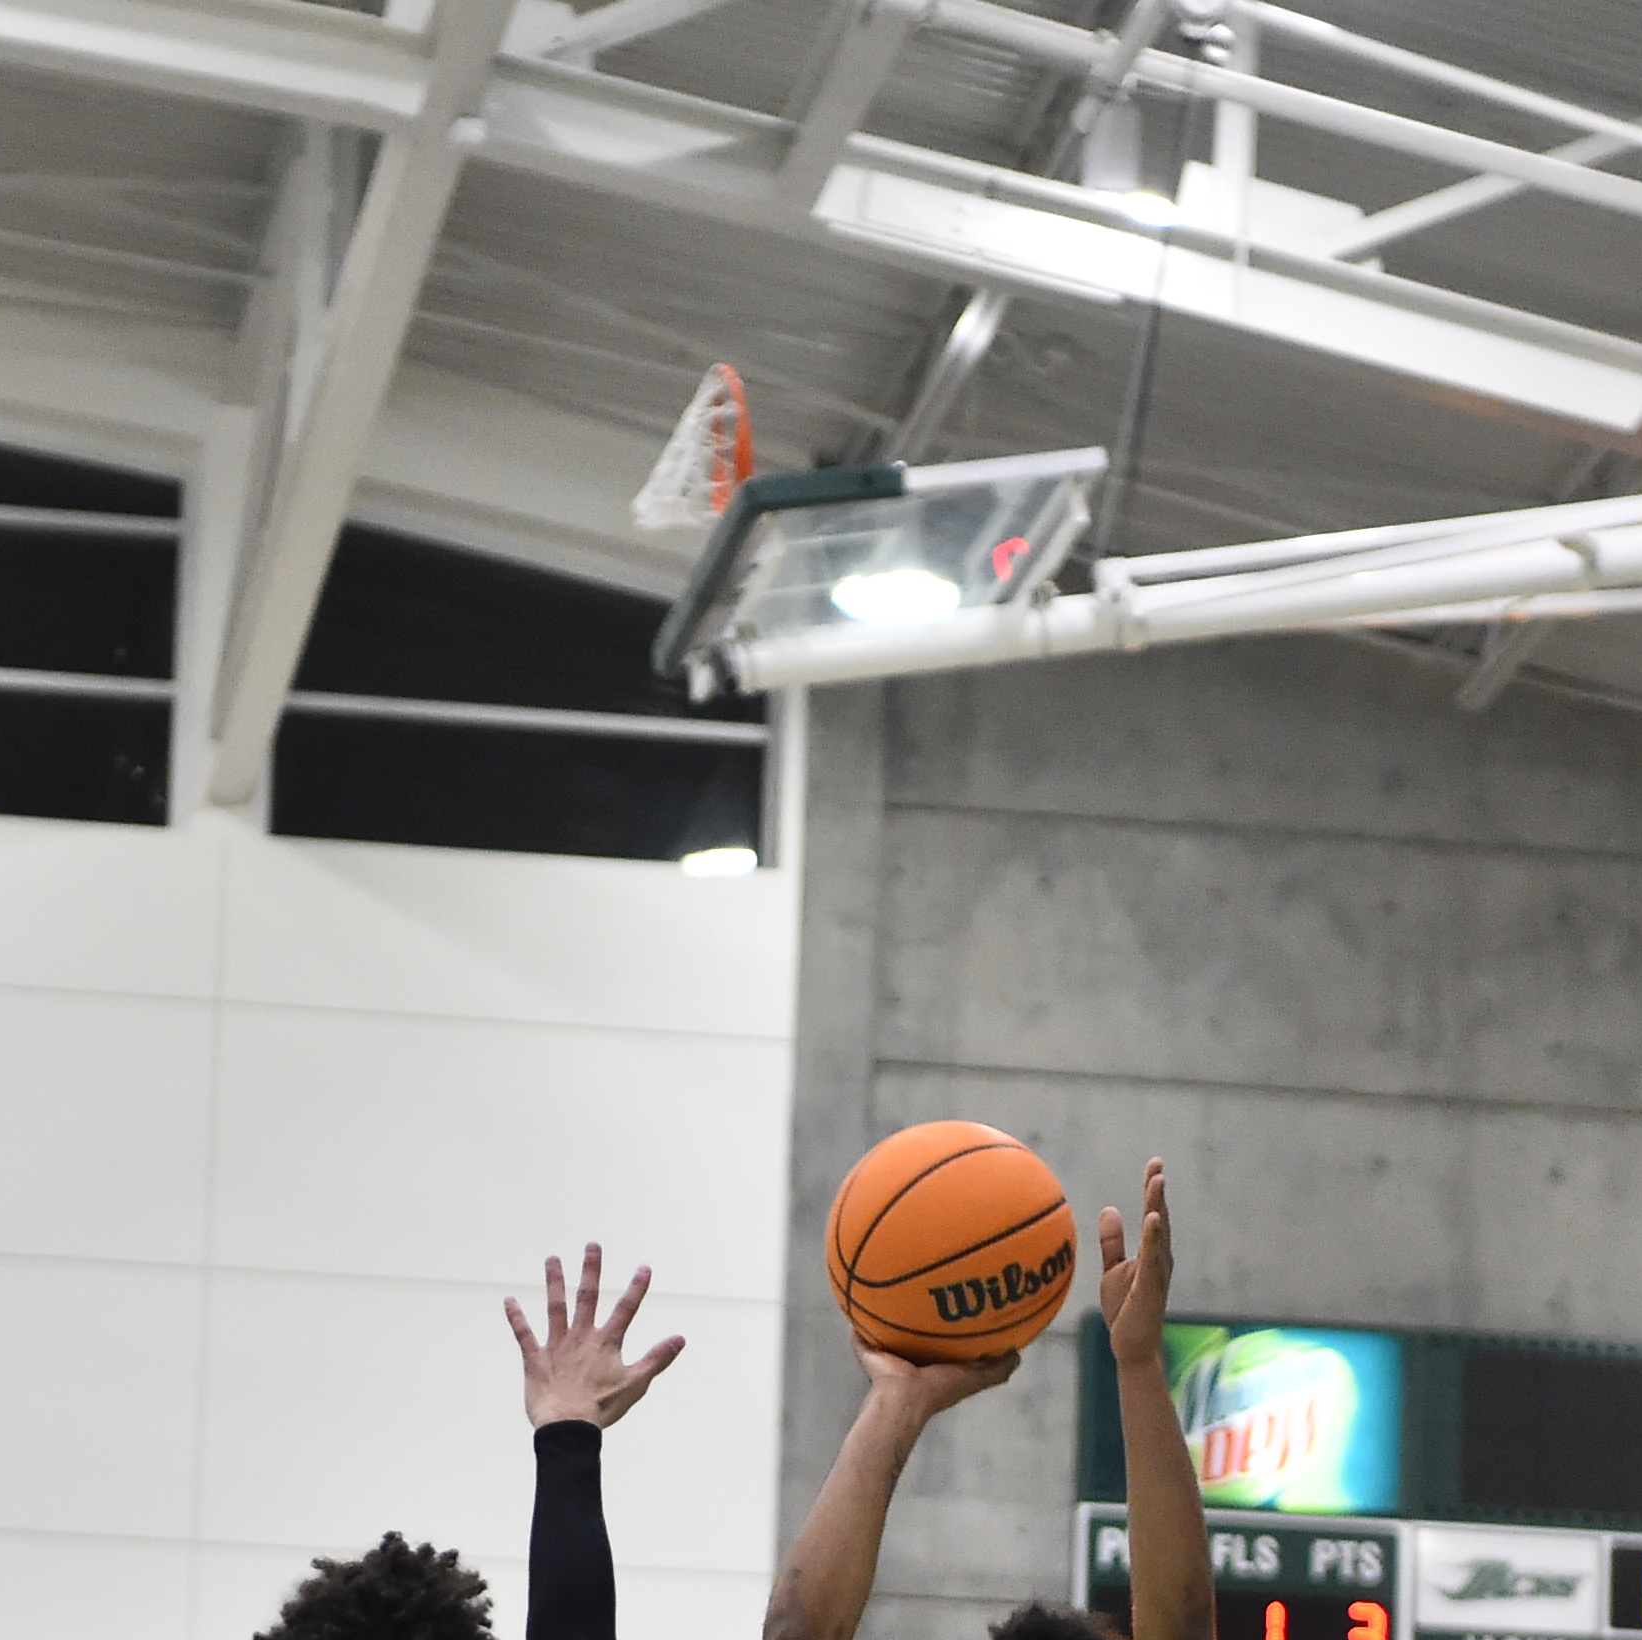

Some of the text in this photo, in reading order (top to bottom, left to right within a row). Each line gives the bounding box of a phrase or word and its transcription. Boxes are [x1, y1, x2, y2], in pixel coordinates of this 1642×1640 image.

[929, 1238, 1075, 1323] Wilson
[1211, 1533, 1279, 1578] FLS
[1310, 1539, 1384, 1585] PTS
